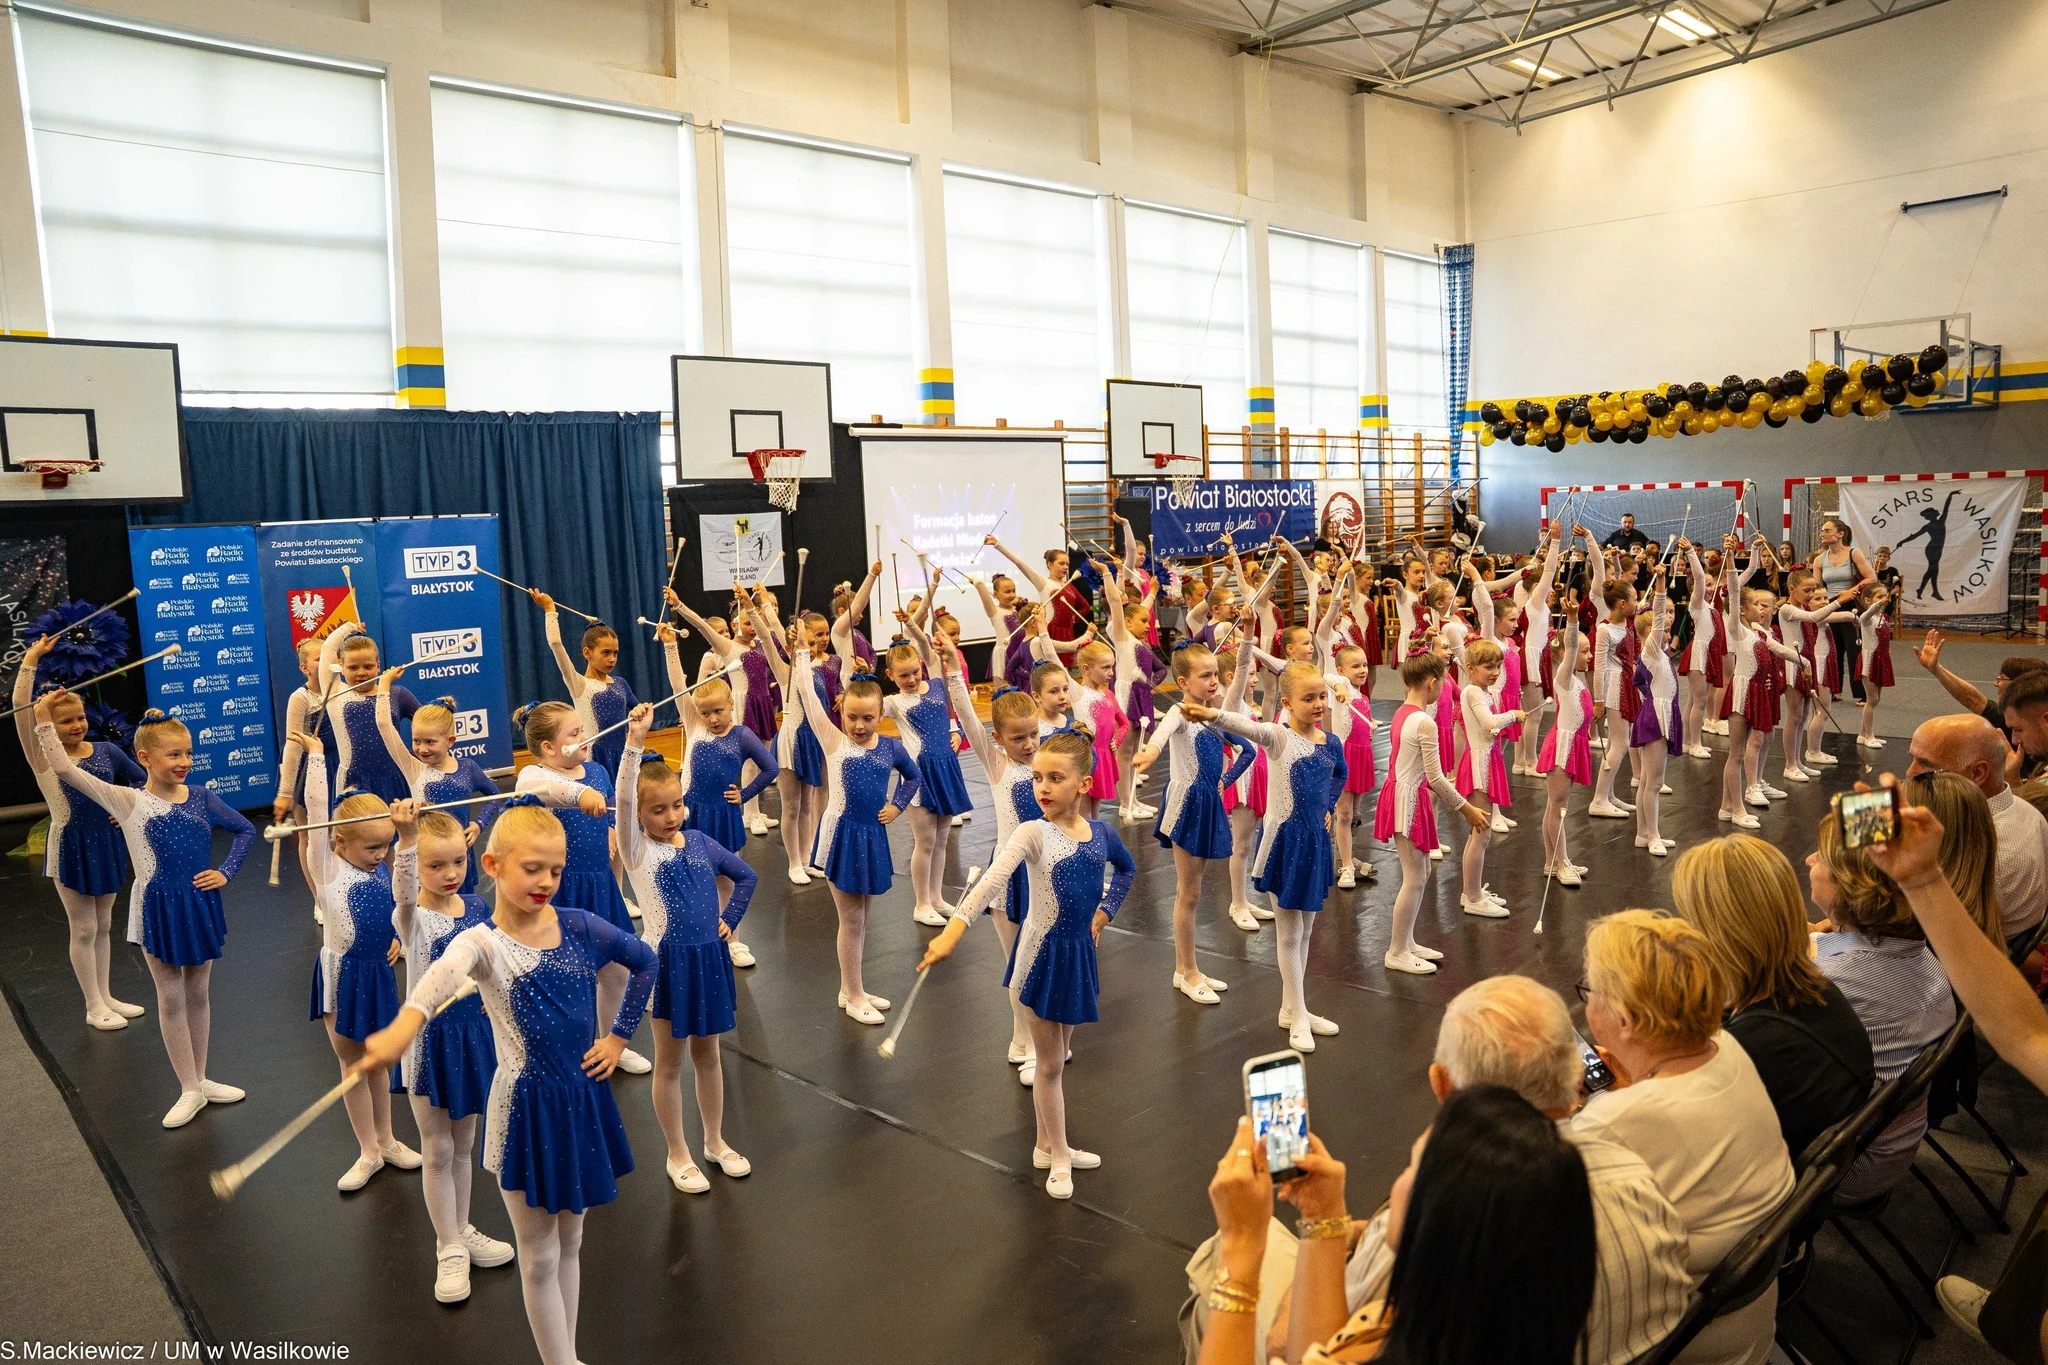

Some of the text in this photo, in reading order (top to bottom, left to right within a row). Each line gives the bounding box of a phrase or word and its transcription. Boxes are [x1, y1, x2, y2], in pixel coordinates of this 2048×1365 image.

[1156, 483, 1310, 510] Powiat Białostocki
[1872, 488, 1934, 529] STARS
[914, 512, 997, 529] Formacja baton
[1186, 514, 1256, 532] z sercem do ludzi
[271, 540, 303, 548] Zadanie
[1953, 498, 1997, 603] WASILKÓW
[308, 556, 364, 565] Białostockiego
[411, 581, 474, 595] BIAŁYSTOK
[0, 594, 30, 672] ASILKÓ
[419, 663, 479, 679] BIAŁYSTOK
[449, 744, 486, 758] YSTOK
[190, 764, 212, 773] ystok
